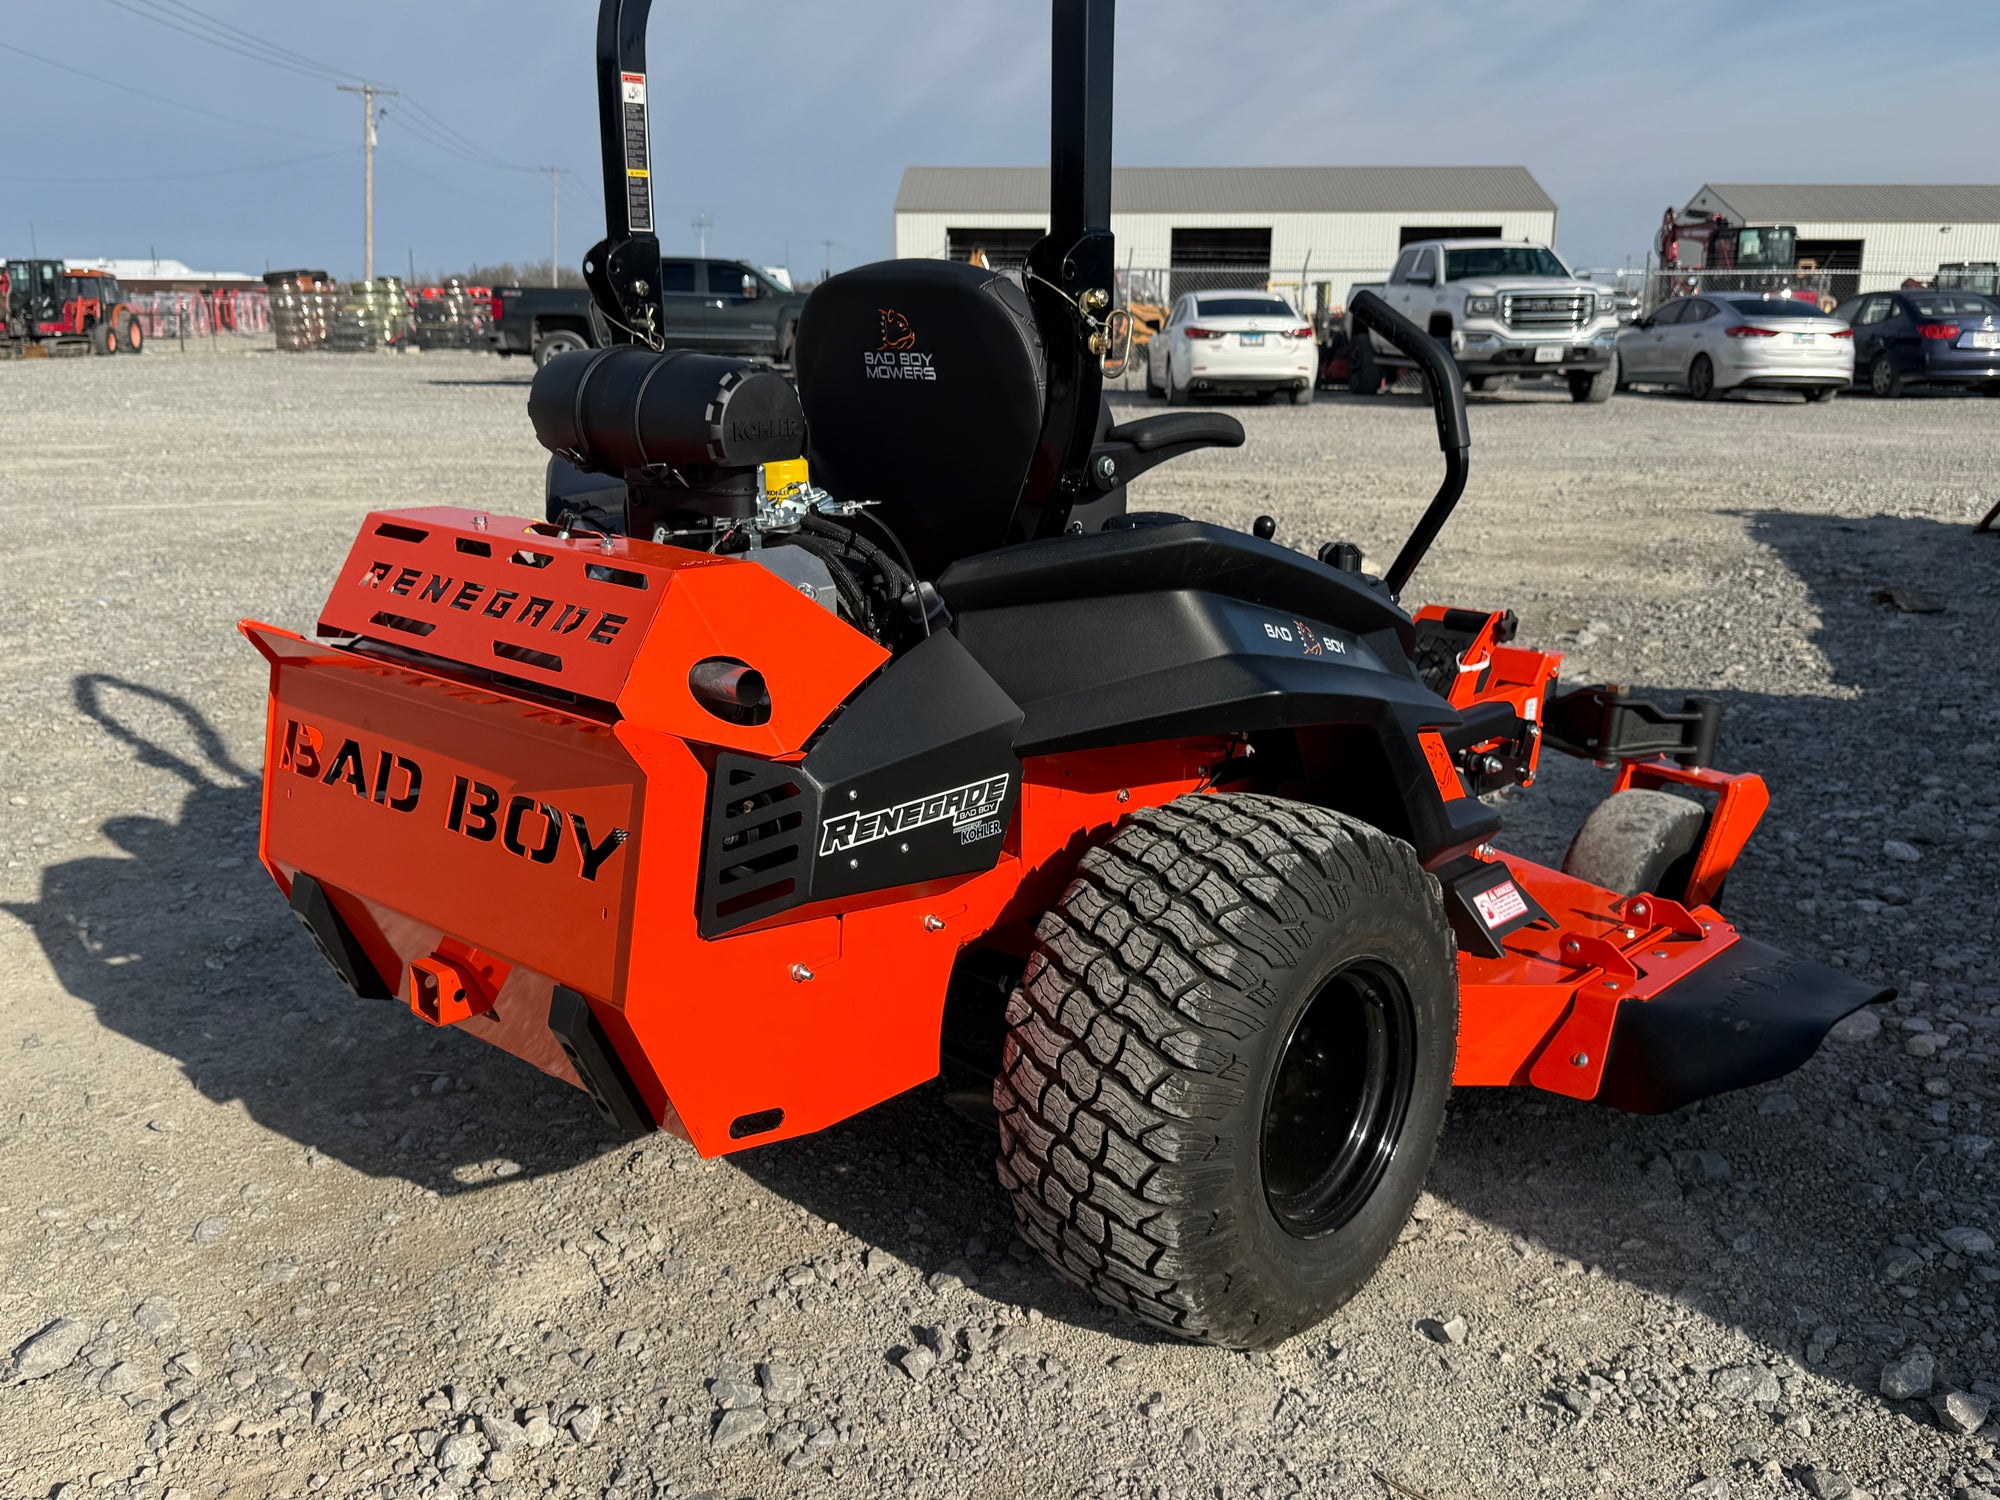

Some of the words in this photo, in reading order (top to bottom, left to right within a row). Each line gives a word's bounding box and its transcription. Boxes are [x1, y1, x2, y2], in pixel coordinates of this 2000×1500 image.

[864, 351, 895, 365] BAD
[899, 352, 933, 366] BOY
[866, 365, 936, 381] MOWERS
[733, 417, 802, 442] KOHLER
[359, 560, 628, 646] RENEGADE
[1263, 622, 1293, 642] BAD
[1322, 636, 1346, 655] BOY
[279, 718, 423, 813] BAD
[444, 773, 631, 882] BOY
[959, 809, 977, 820] BAD
[978, 803, 995, 814] BOY
[820, 774, 1009, 856] RENEGADE
[960, 820, 1002, 845] KOHLER
